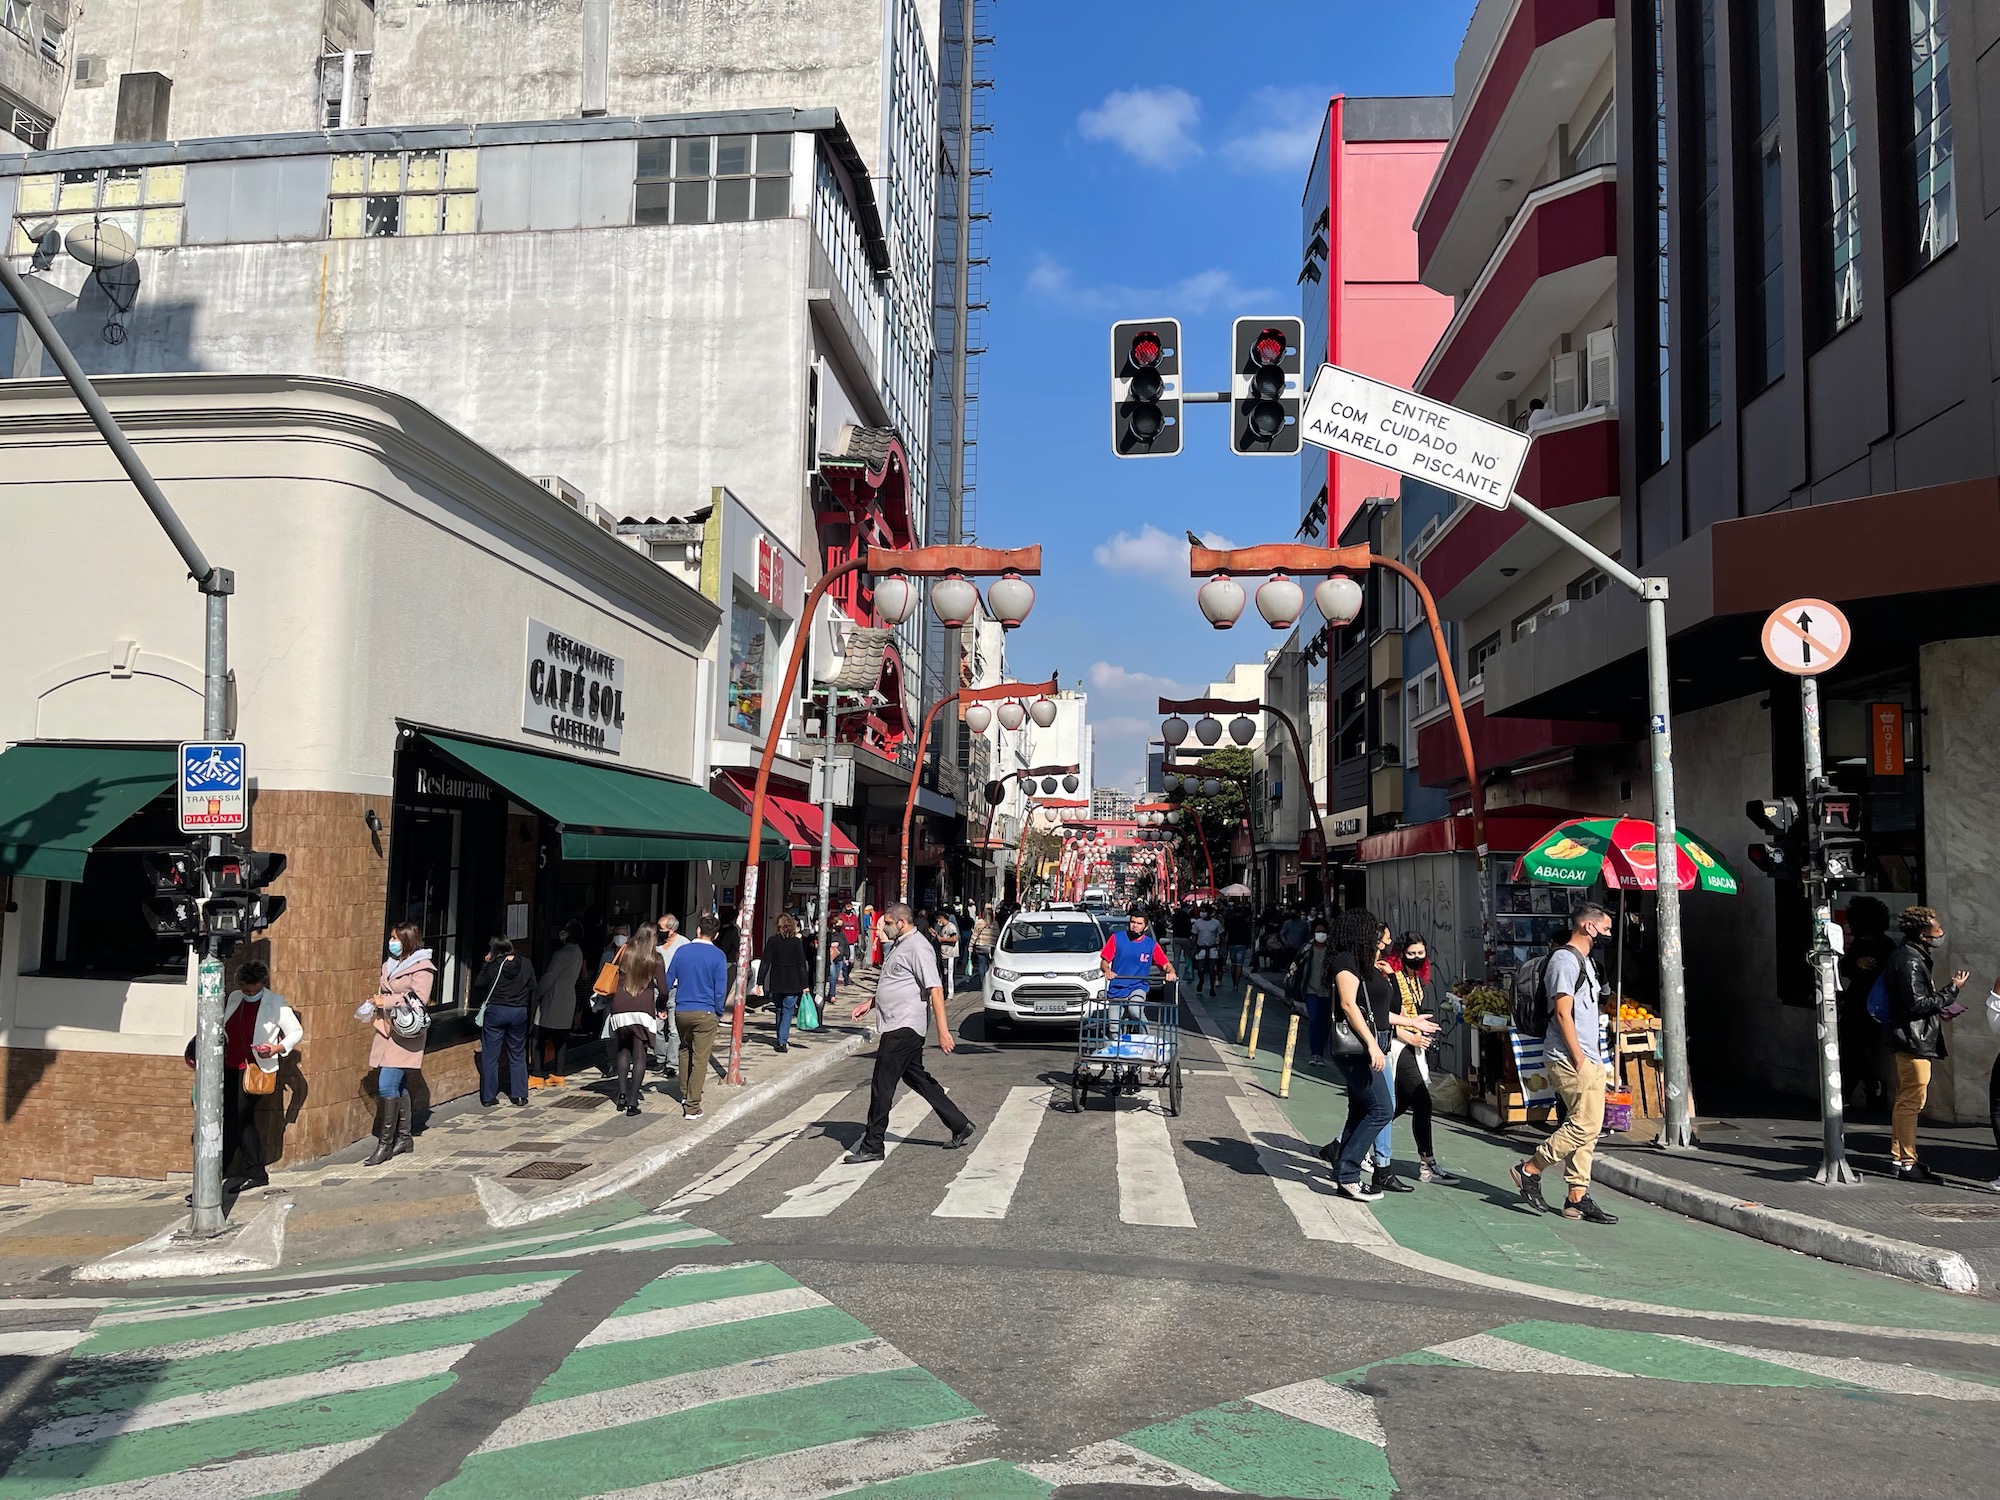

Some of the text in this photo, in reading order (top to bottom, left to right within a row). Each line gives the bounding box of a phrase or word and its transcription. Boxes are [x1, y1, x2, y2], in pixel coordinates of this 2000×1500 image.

[1391, 399, 1451, 431] ENTRE
[1330, 401, 1496, 470] COM CUIDADO NO
[1309, 418, 1502, 496] AMARELO PISCANTE
[547, 631, 615, 679] RESTAURANTE
[530, 658, 625, 728] CAFÉ SOL
[550, 714, 605, 748] CAFETERIA
[186, 794, 241, 803] TRAVESSIA
[185, 815, 241, 823] DIAGONAL
[1533, 865, 1587, 881] ABACAXI
